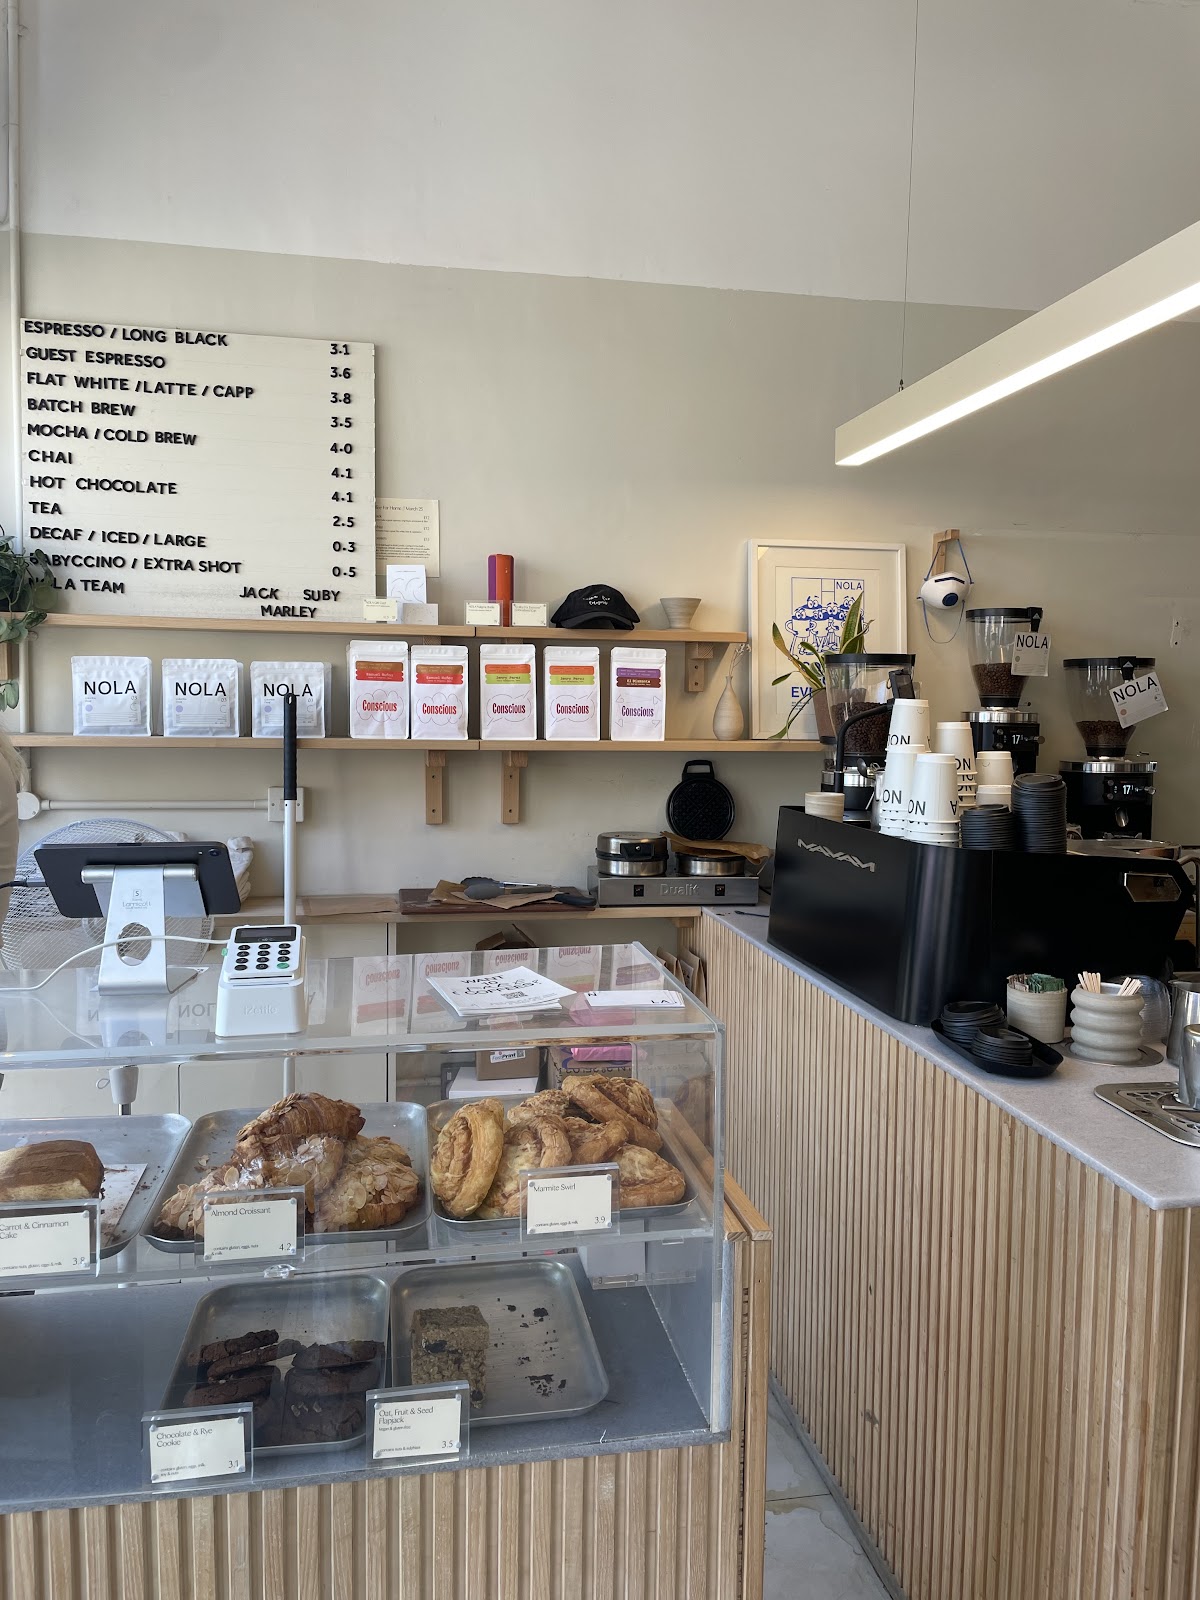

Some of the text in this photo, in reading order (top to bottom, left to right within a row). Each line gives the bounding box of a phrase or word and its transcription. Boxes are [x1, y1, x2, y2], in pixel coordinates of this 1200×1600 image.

[24, 320, 350, 356] ESPRESSO / LONG BLACK 3.1
[26, 346, 352, 379] GUEST ESPRESSO 3.6
[27, 372, 66, 388] FLAT
[74, 376, 129, 392] WHITE
[213, 385, 255, 399] CAPP
[330, 392, 352, 404] 3.8
[28, 398, 352, 428] BATCH BREW 3.5
[28, 424, 88, 440] MOCHA
[155, 432, 197, 446] BREW
[330, 442, 353, 455] 4.0
[28, 449, 353, 480] CHAI 4.1
[30, 476, 354, 504] HOT CHOCOLATE 4.1
[29, 502, 355, 528] TEA 2.5
[30, 526, 356, 553] DECAF / ICED / LARGE 0.3
[131, 558, 138, 570] /
[144, 558, 194, 572] EXTRA
[198, 560, 242, 575] SHOT
[332, 566, 356, 578] 0.5
[80, 580, 124, 594] TEAM
[836, 581, 862, 590] NOLA
[240, 586, 340, 602] JACK SUBY
[260, 604, 317, 620] MARLEY
[1016, 635, 1048, 649] NOLA
[84, 680, 136, 694] NOLA
[176, 682, 226, 696] NOLA
[264, 684, 313, 696] NOLA
[1113, 676, 1157, 702] NOLA
[363, 700, 398, 712] Conscious
[422, 703, 456, 714] Conscious
[492, 703, 526, 714] Conscious
[556, 703, 589, 714] Conscious
[622, 706, 654, 717] Conscious
[211, 1208, 237, 1217] Almond
[595, 1216, 605, 1224] 3.9
[279, 1242, 291, 1251] 4.2
[379, 1416, 404, 1425] Flapjack
[156, 1430, 191, 1440] Chocolate
[200, 1427, 212, 1435] Rye
[442, 1440, 453, 1448] 3.5
[229, 1460, 239, 1468] 3.1
